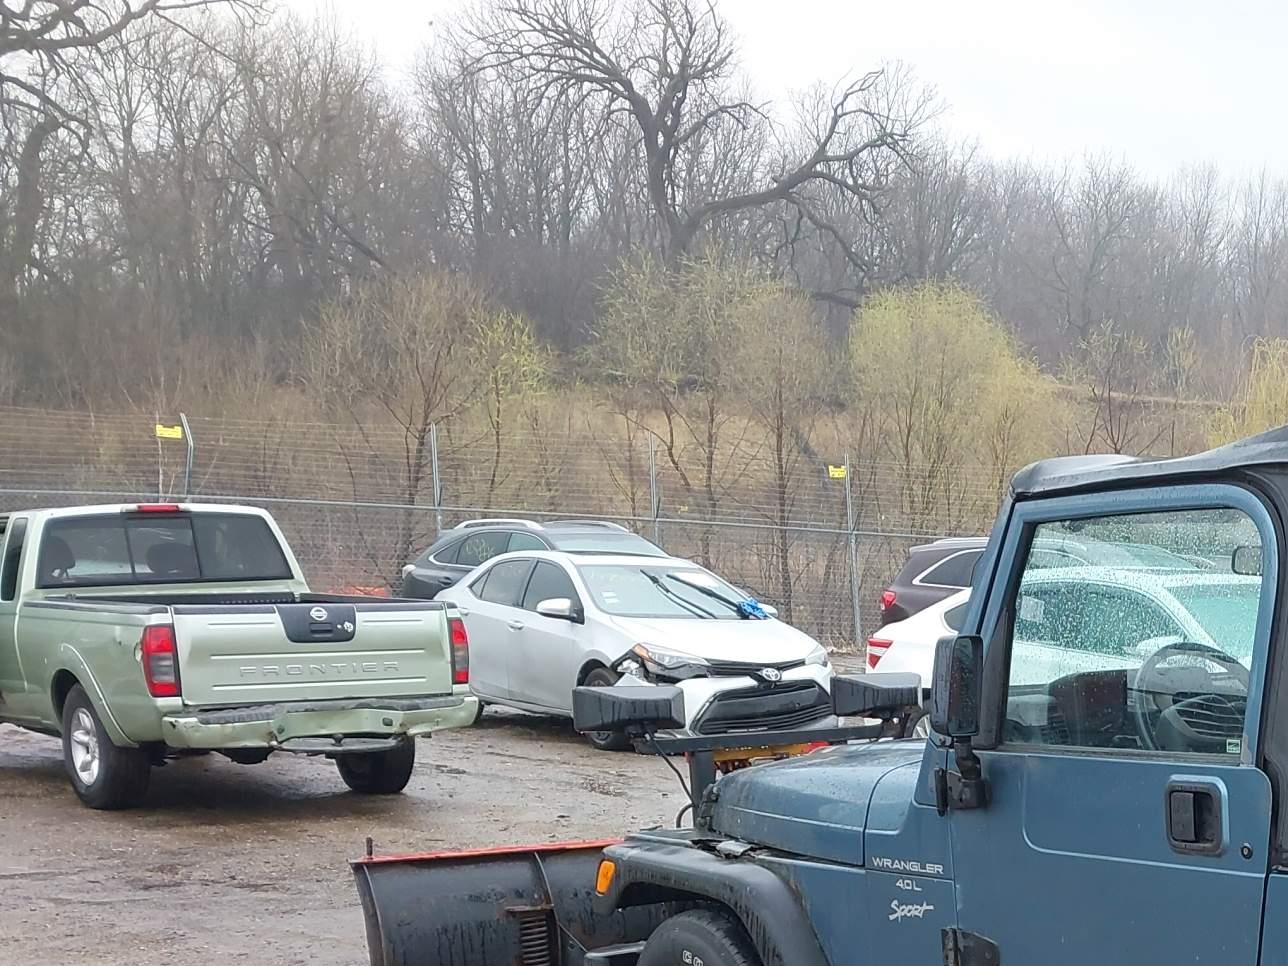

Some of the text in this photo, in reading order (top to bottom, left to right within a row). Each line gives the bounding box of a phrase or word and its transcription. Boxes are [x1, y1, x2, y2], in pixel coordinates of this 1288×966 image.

[239, 661, 400, 678] FRONTIER
[871, 856, 944, 875] WRANGLER
[888, 899, 934, 923] Sport
